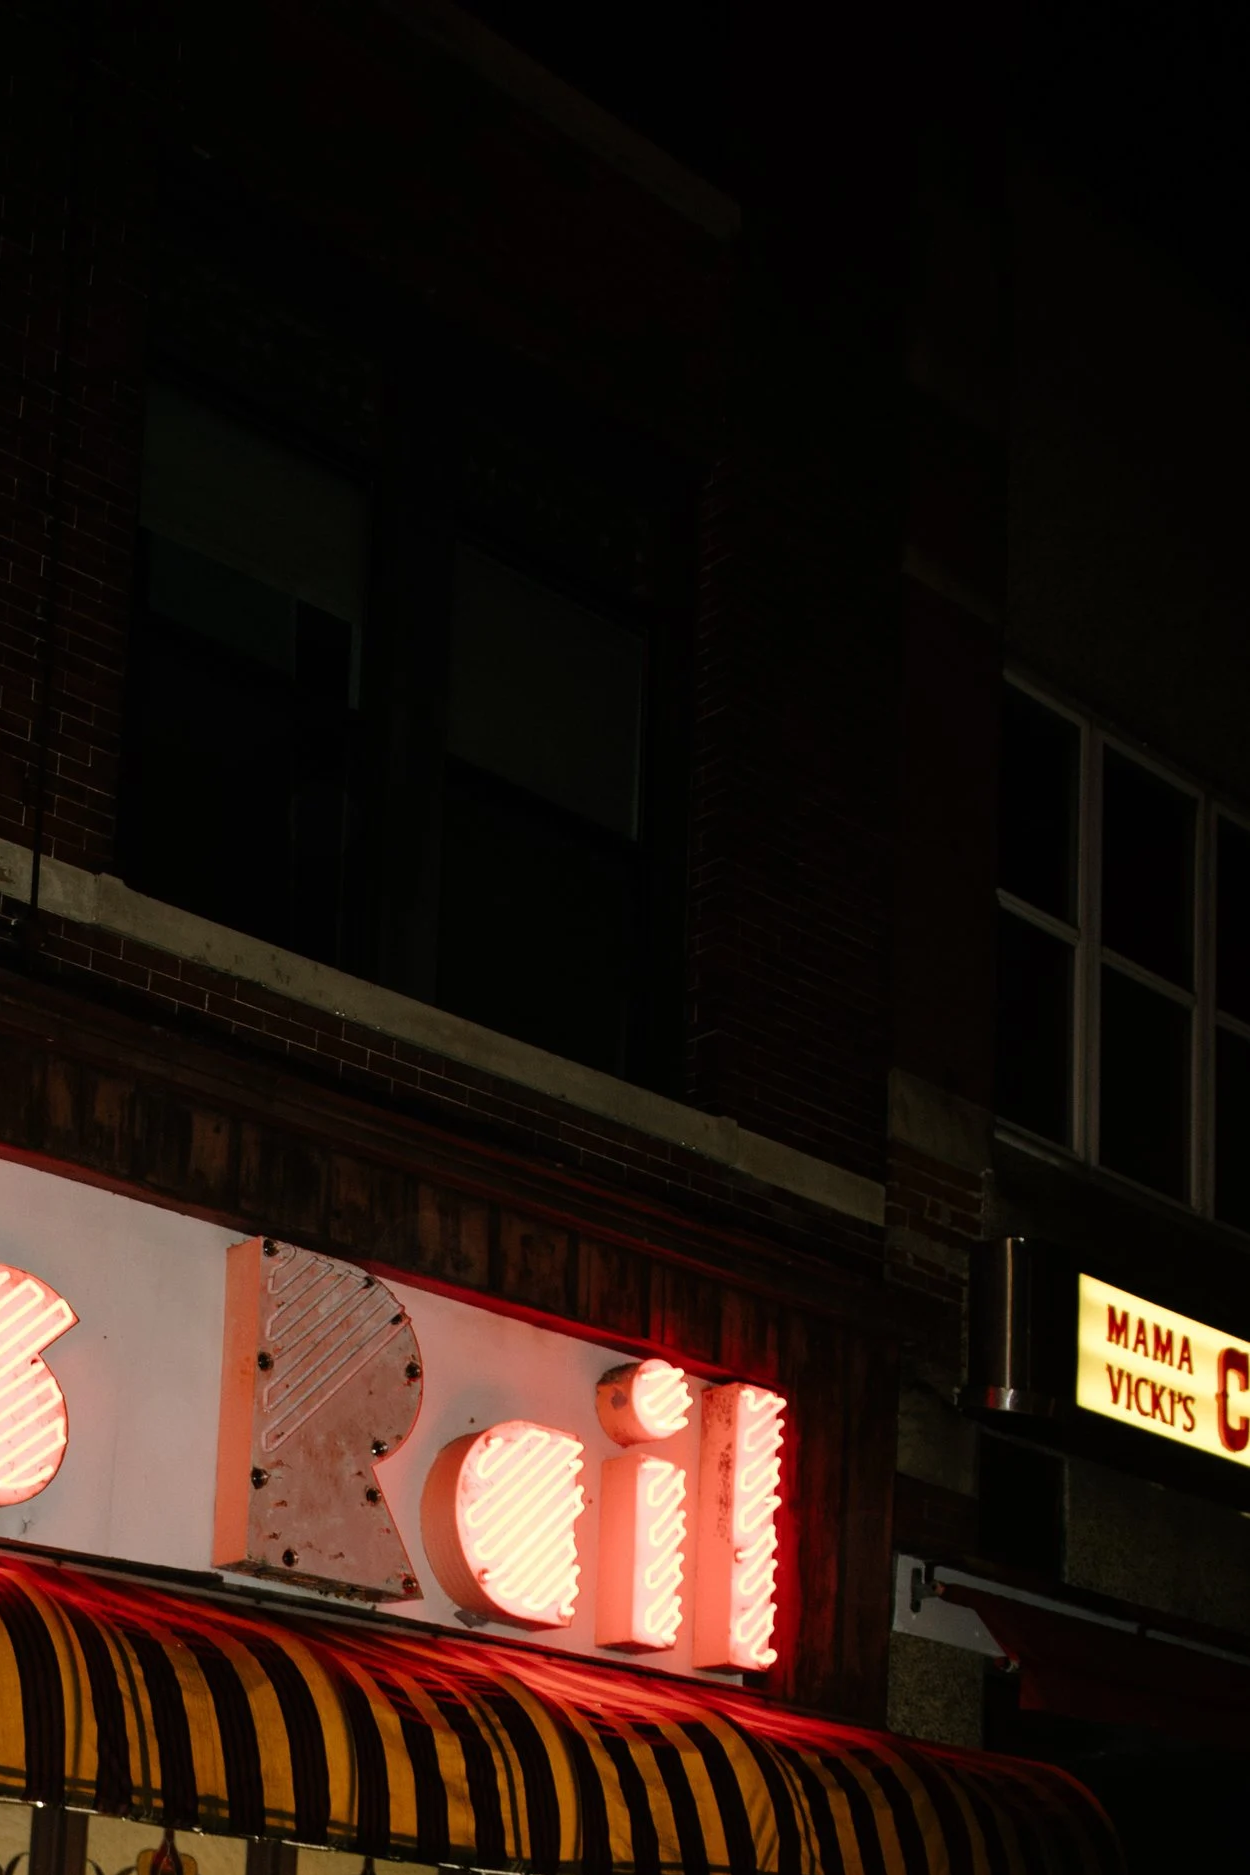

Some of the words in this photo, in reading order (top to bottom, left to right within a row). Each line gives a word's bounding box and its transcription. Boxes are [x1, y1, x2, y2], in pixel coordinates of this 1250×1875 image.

[1106, 1303, 1194, 1375] MAMA
[1106, 1363, 1196, 1433] VICKI'S
[211, 1235, 787, 1674] Rail
